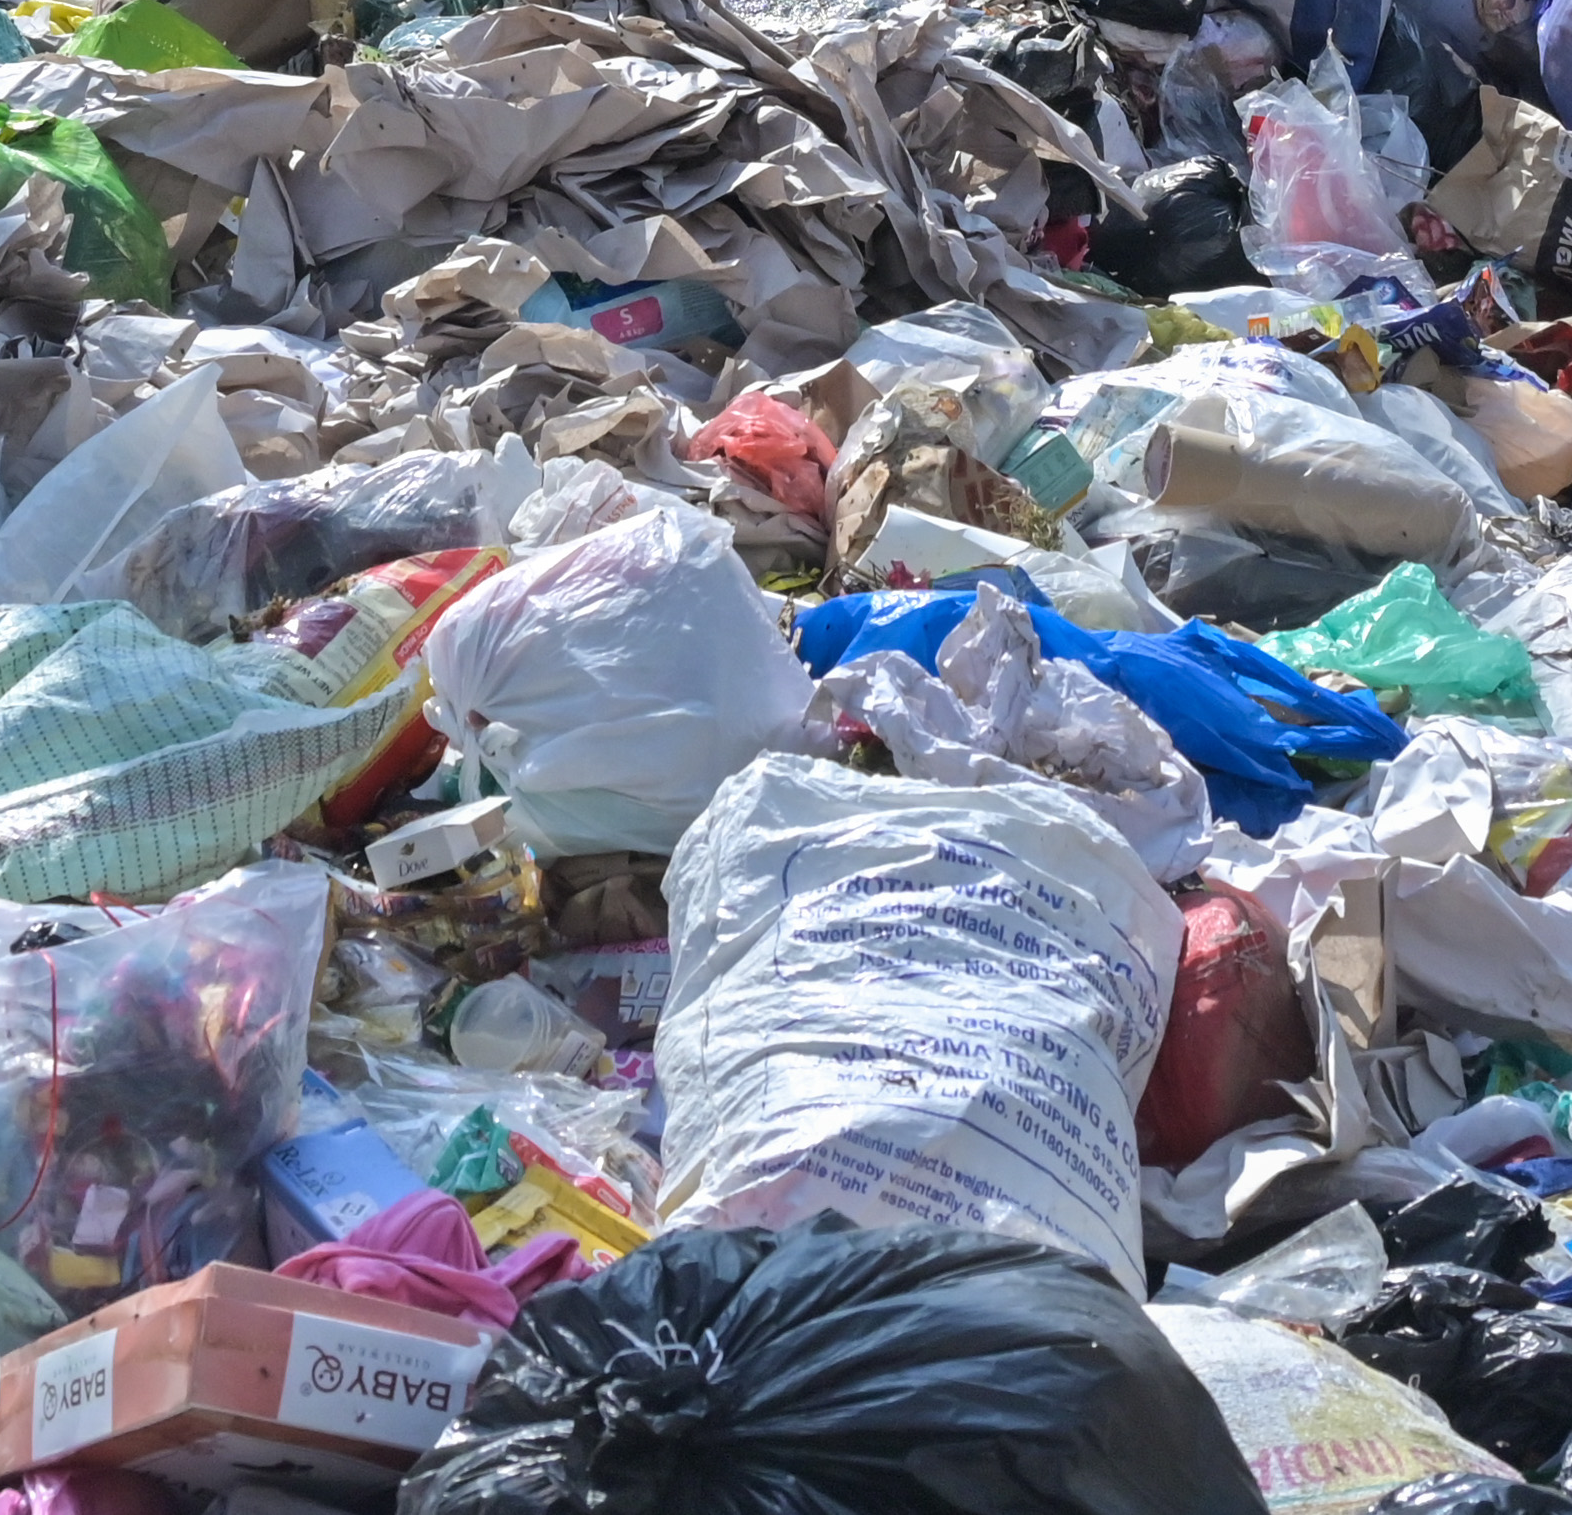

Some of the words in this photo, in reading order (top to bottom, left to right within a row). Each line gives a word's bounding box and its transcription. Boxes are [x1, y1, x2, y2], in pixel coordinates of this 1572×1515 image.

[619, 307, 634, 325] S
[398, 858, 428, 877] Dove
[1042, 1034, 1068, 1062] by
[1003, 1047, 1102, 1125] TRADING
[981, 1090, 1009, 1119] No.
[830, 1173, 867, 1196] right
